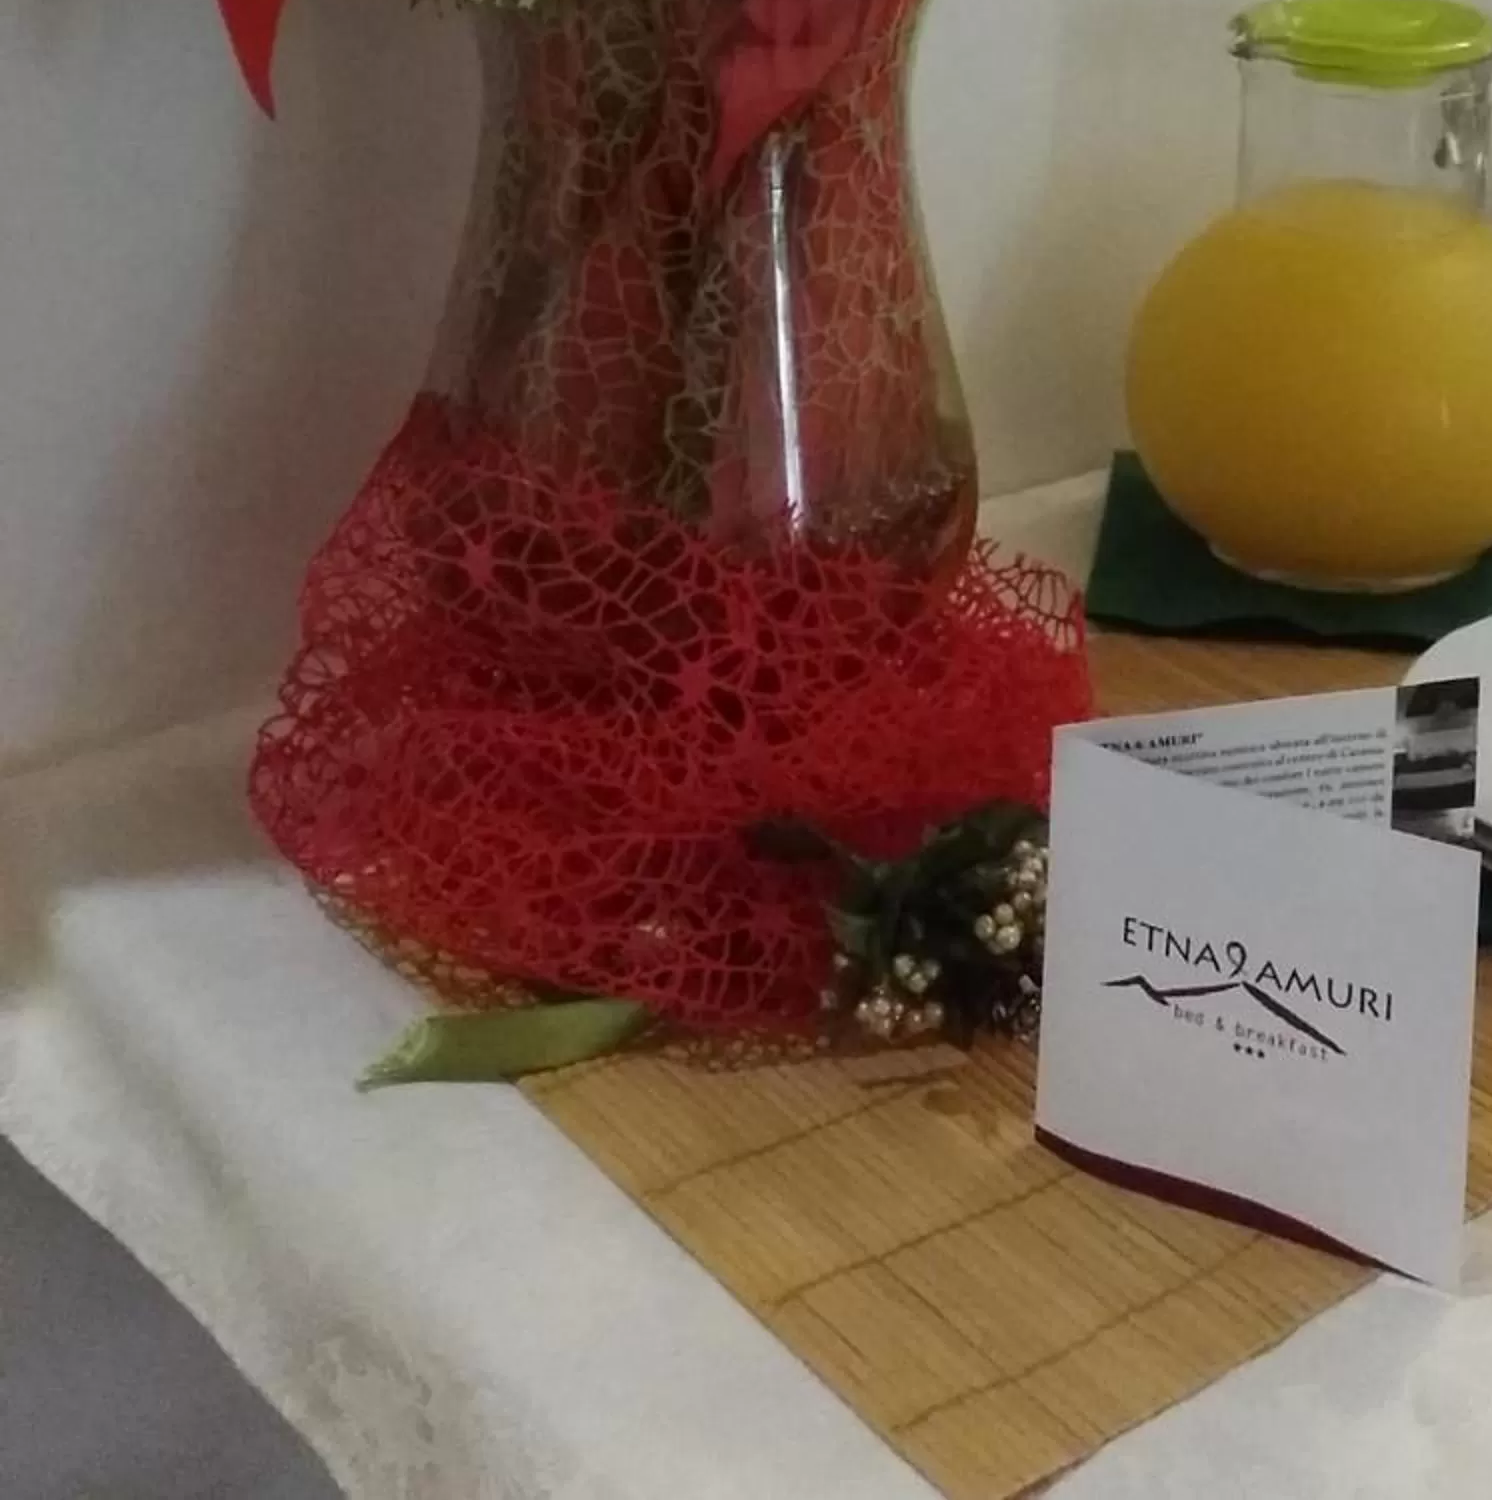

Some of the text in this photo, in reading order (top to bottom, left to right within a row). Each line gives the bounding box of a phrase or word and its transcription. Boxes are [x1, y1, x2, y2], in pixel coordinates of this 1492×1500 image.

[1122, 915, 1222, 974] ETNA
[1254, 960, 1394, 1022] AMURI
[1173, 1004, 1205, 1028] bed
[1234, 1021, 1330, 1063] breakfast
